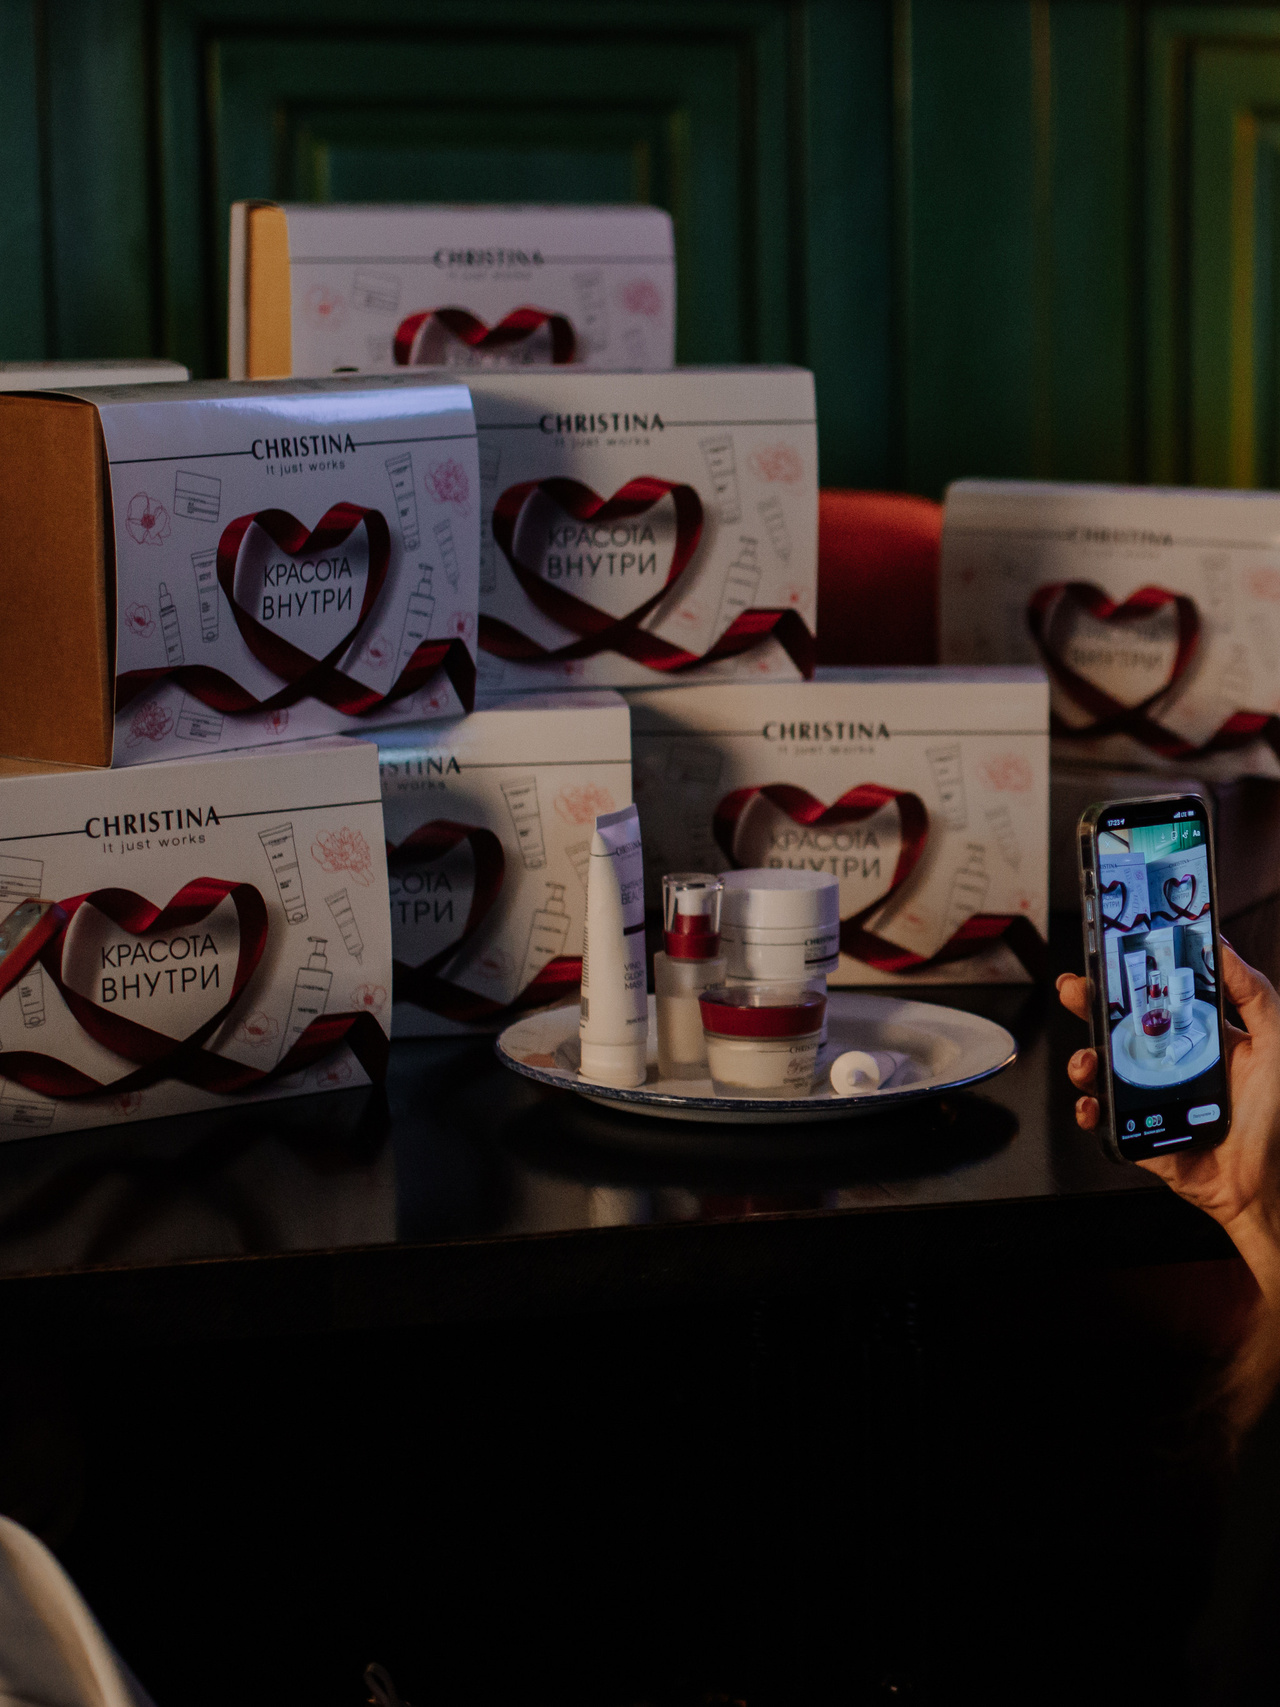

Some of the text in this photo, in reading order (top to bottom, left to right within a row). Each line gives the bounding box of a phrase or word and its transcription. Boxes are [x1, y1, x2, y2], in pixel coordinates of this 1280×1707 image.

[539, 413, 665, 434] CHRISTINA
[252, 433, 356, 461] CHRISTINA
[280, 461, 303, 477] just
[309, 460, 345, 472] works
[549, 524, 656, 548] КРАСОТА
[264, 557, 352, 588] КРАСОТА
[548, 552, 656, 579] ВНУТРИ
[262, 586, 352, 620] ВНУТРИ
[762, 721, 889, 742] CHRISTINA
[85, 805, 221, 839] CHRISTINA
[103, 833, 206, 854] It just works
[101, 934, 219, 969] КРАСОТА
[102, 963, 220, 1003] ВНУТРИ
